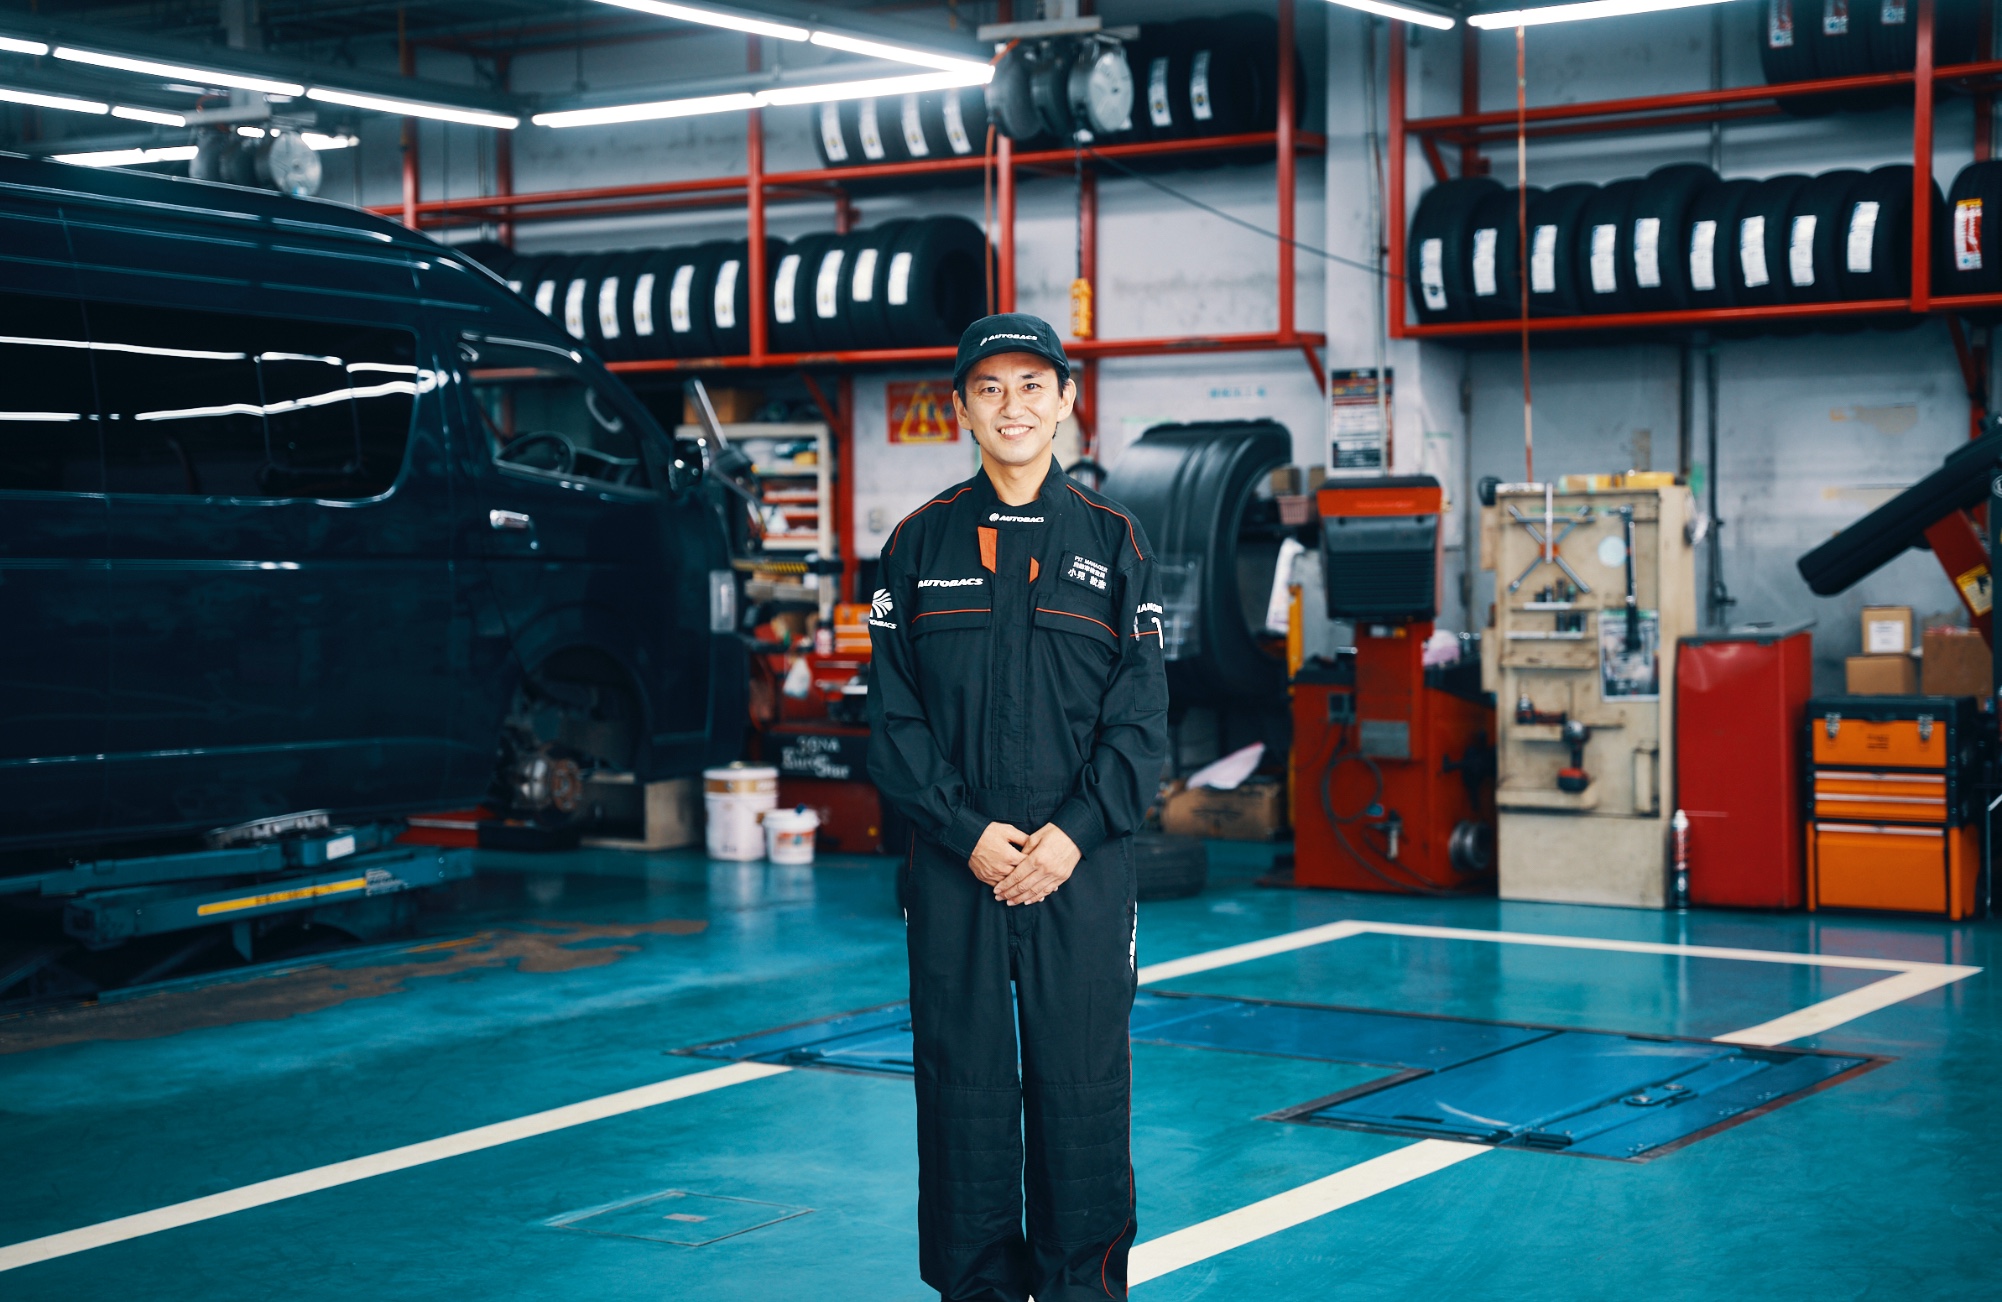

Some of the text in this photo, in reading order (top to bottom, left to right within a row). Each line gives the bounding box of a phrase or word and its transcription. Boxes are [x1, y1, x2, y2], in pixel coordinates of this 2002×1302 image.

[987, 333, 1038, 342] AUTOBACS
[999, 515, 1045, 523] AUTOBACS
[917, 577, 984, 588] AUTOBACS
